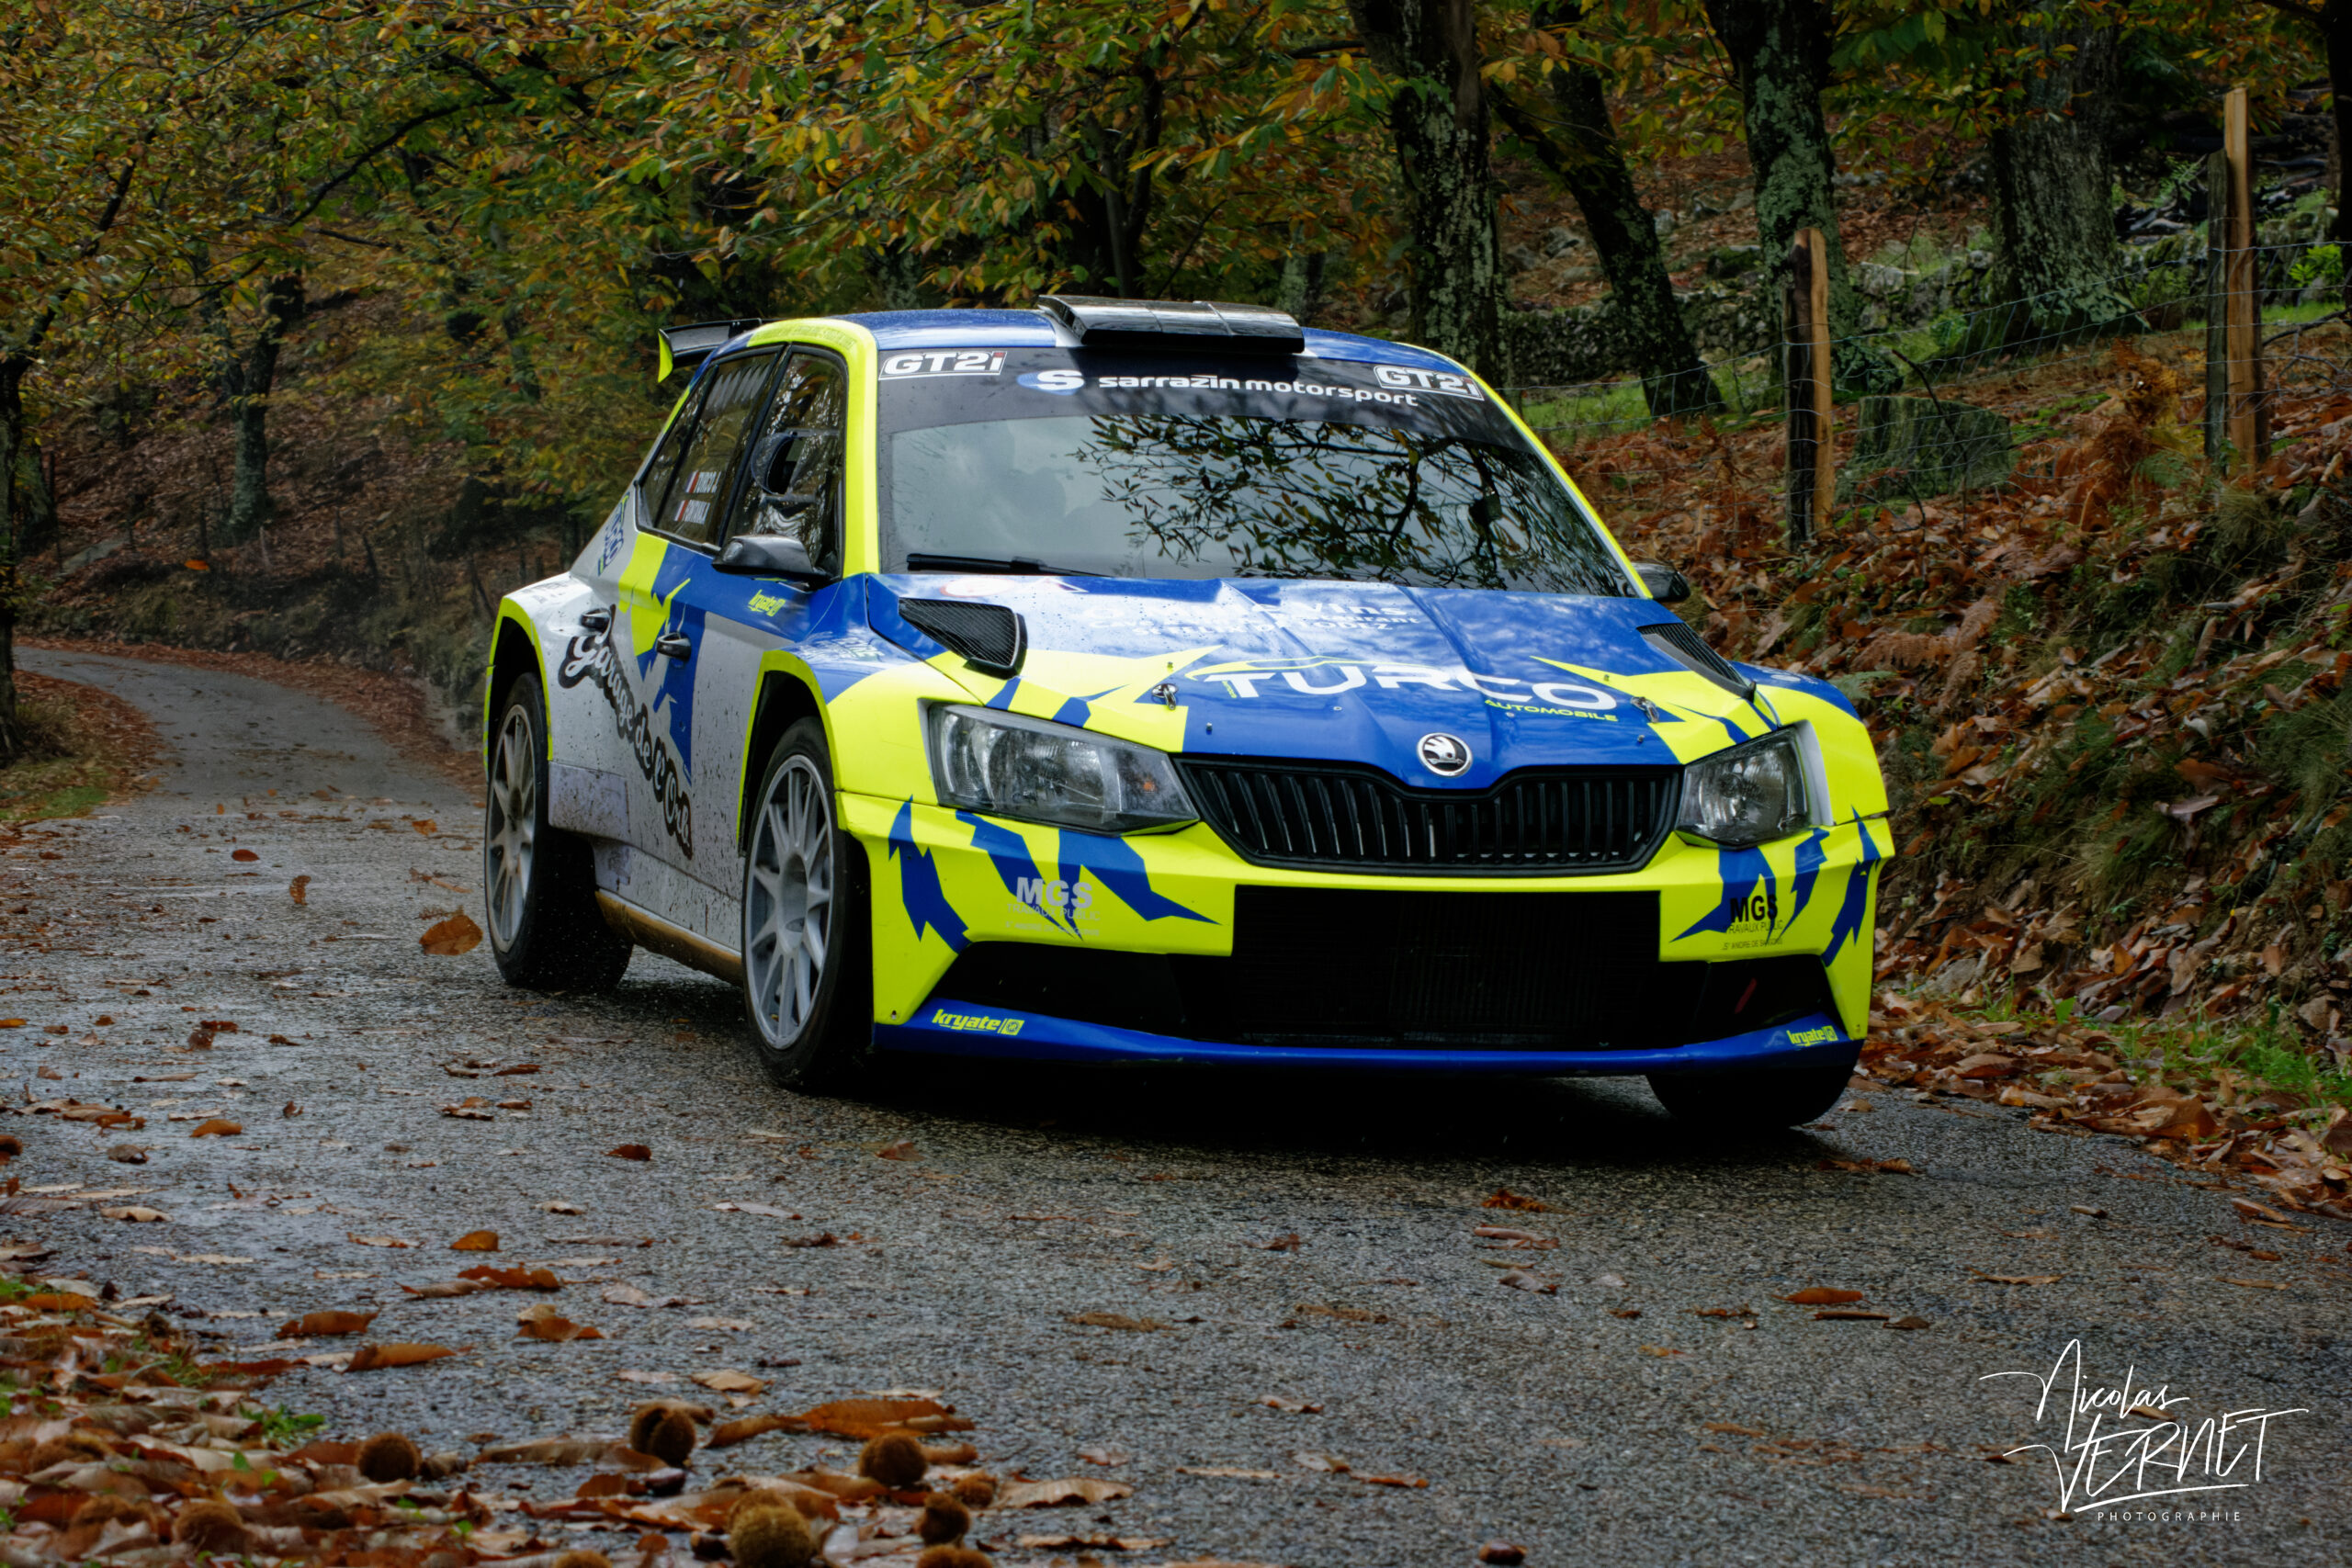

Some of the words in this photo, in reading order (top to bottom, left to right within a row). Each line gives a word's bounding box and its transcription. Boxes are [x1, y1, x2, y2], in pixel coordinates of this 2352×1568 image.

[884, 351, 1006, 376] GT2i
[1099, 374, 1240, 389] sarrazin
[1245, 379, 1419, 406] motorsport
[1376, 367, 1481, 397] GT2i
[563, 617, 634, 732] Garage
[634, 713, 651, 772] de
[1204, 665, 1617, 711] TURCO
[1484, 699, 1619, 722] AUTOMOBILE
[1016, 876, 1093, 908] MGS
[1006, 903, 1057, 918] TRAVAUX
[1059, 908, 1102, 922] PUBLIC
[1730, 894, 1778, 923] MGS
[1723, 921, 1758, 935] RAVAUX
[932, 1009, 1001, 1031] kryate
[1786, 1029, 1826, 1046] kryate
